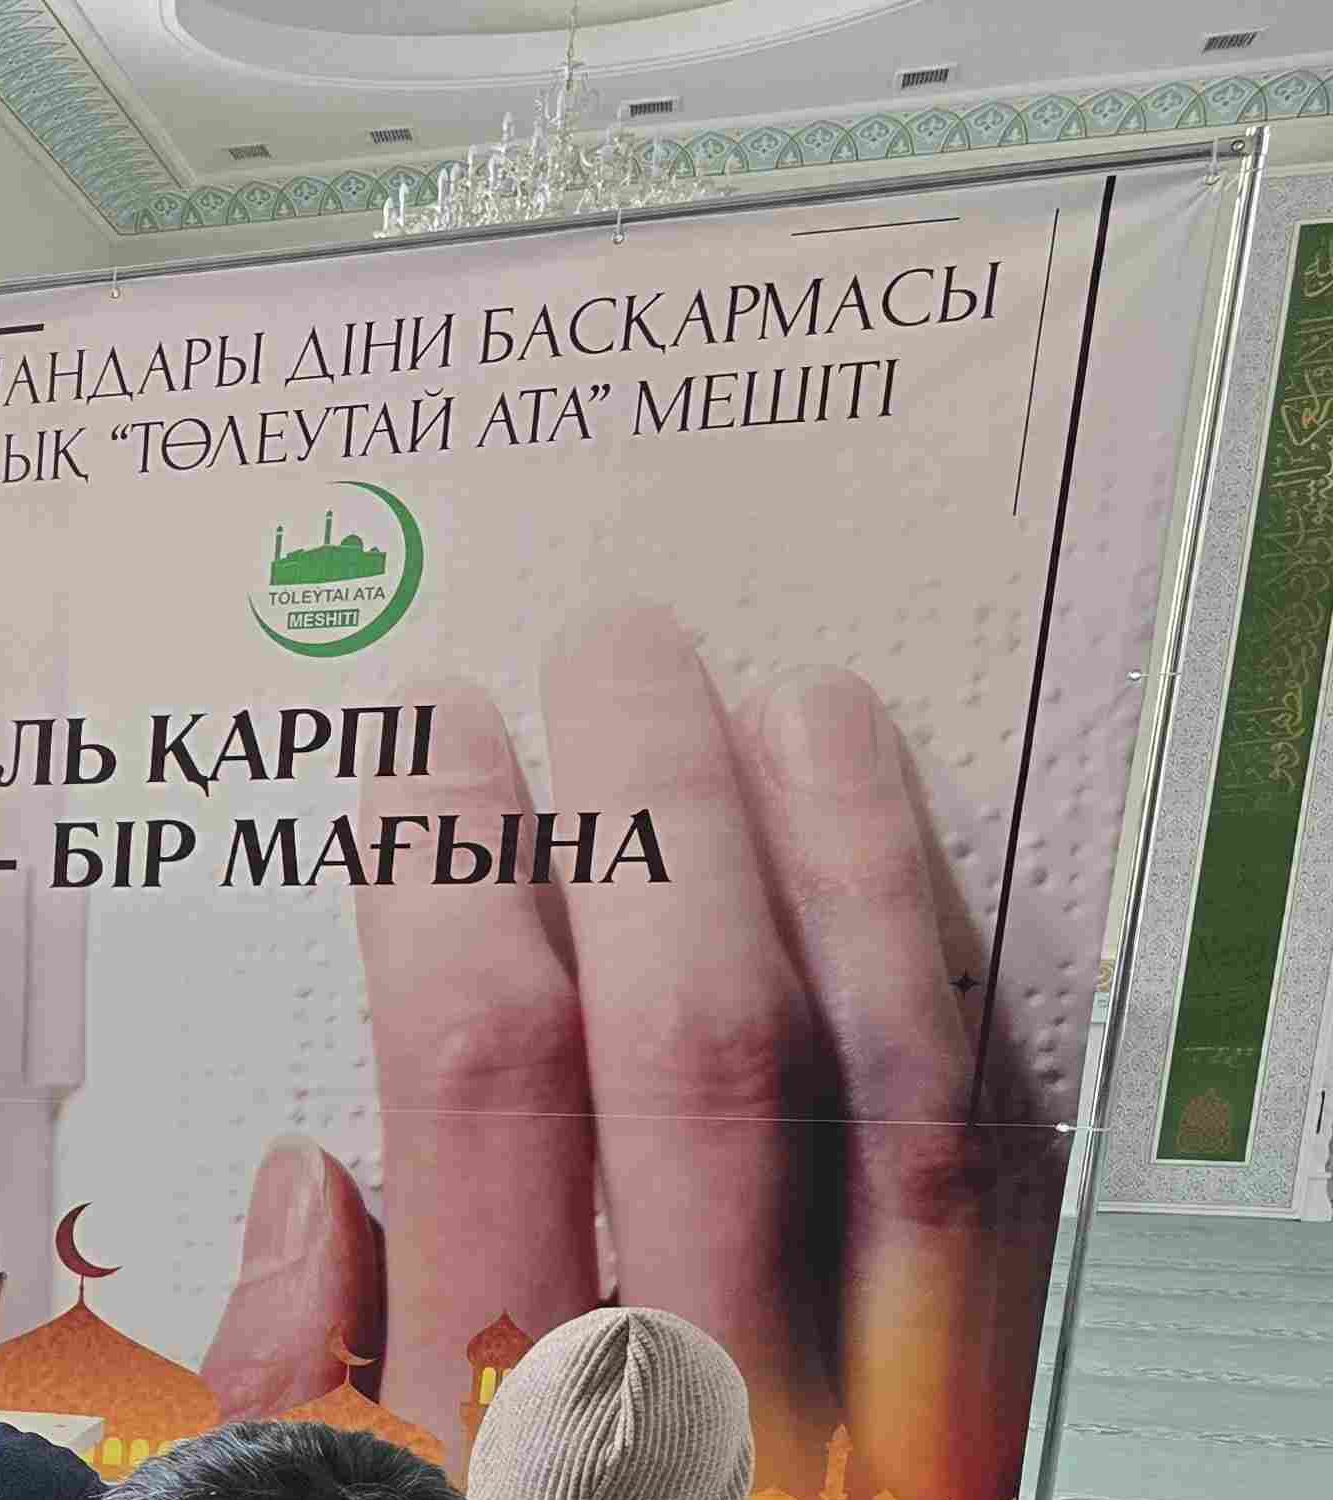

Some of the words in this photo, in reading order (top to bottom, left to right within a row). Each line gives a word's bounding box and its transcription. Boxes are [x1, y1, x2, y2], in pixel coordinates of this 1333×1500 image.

[284, 312, 457, 388] ДІНИ
[479, 261, 1004, 366] БАСҚАРМАСЫ
[110, 387, 456, 475] “ТӨЛЕУТАЙ
[476, 382, 612, 449] АТА”
[631, 358, 901, 437] МЕШІТІ
[289, 611, 358, 628] MESHITI
[353, 585, 386, 601] ATA
[146, 704, 437, 798] ҚАРПІ
[49, 818, 197, 889] БІР
[220, 807, 673, 887] МАҒЫНА
